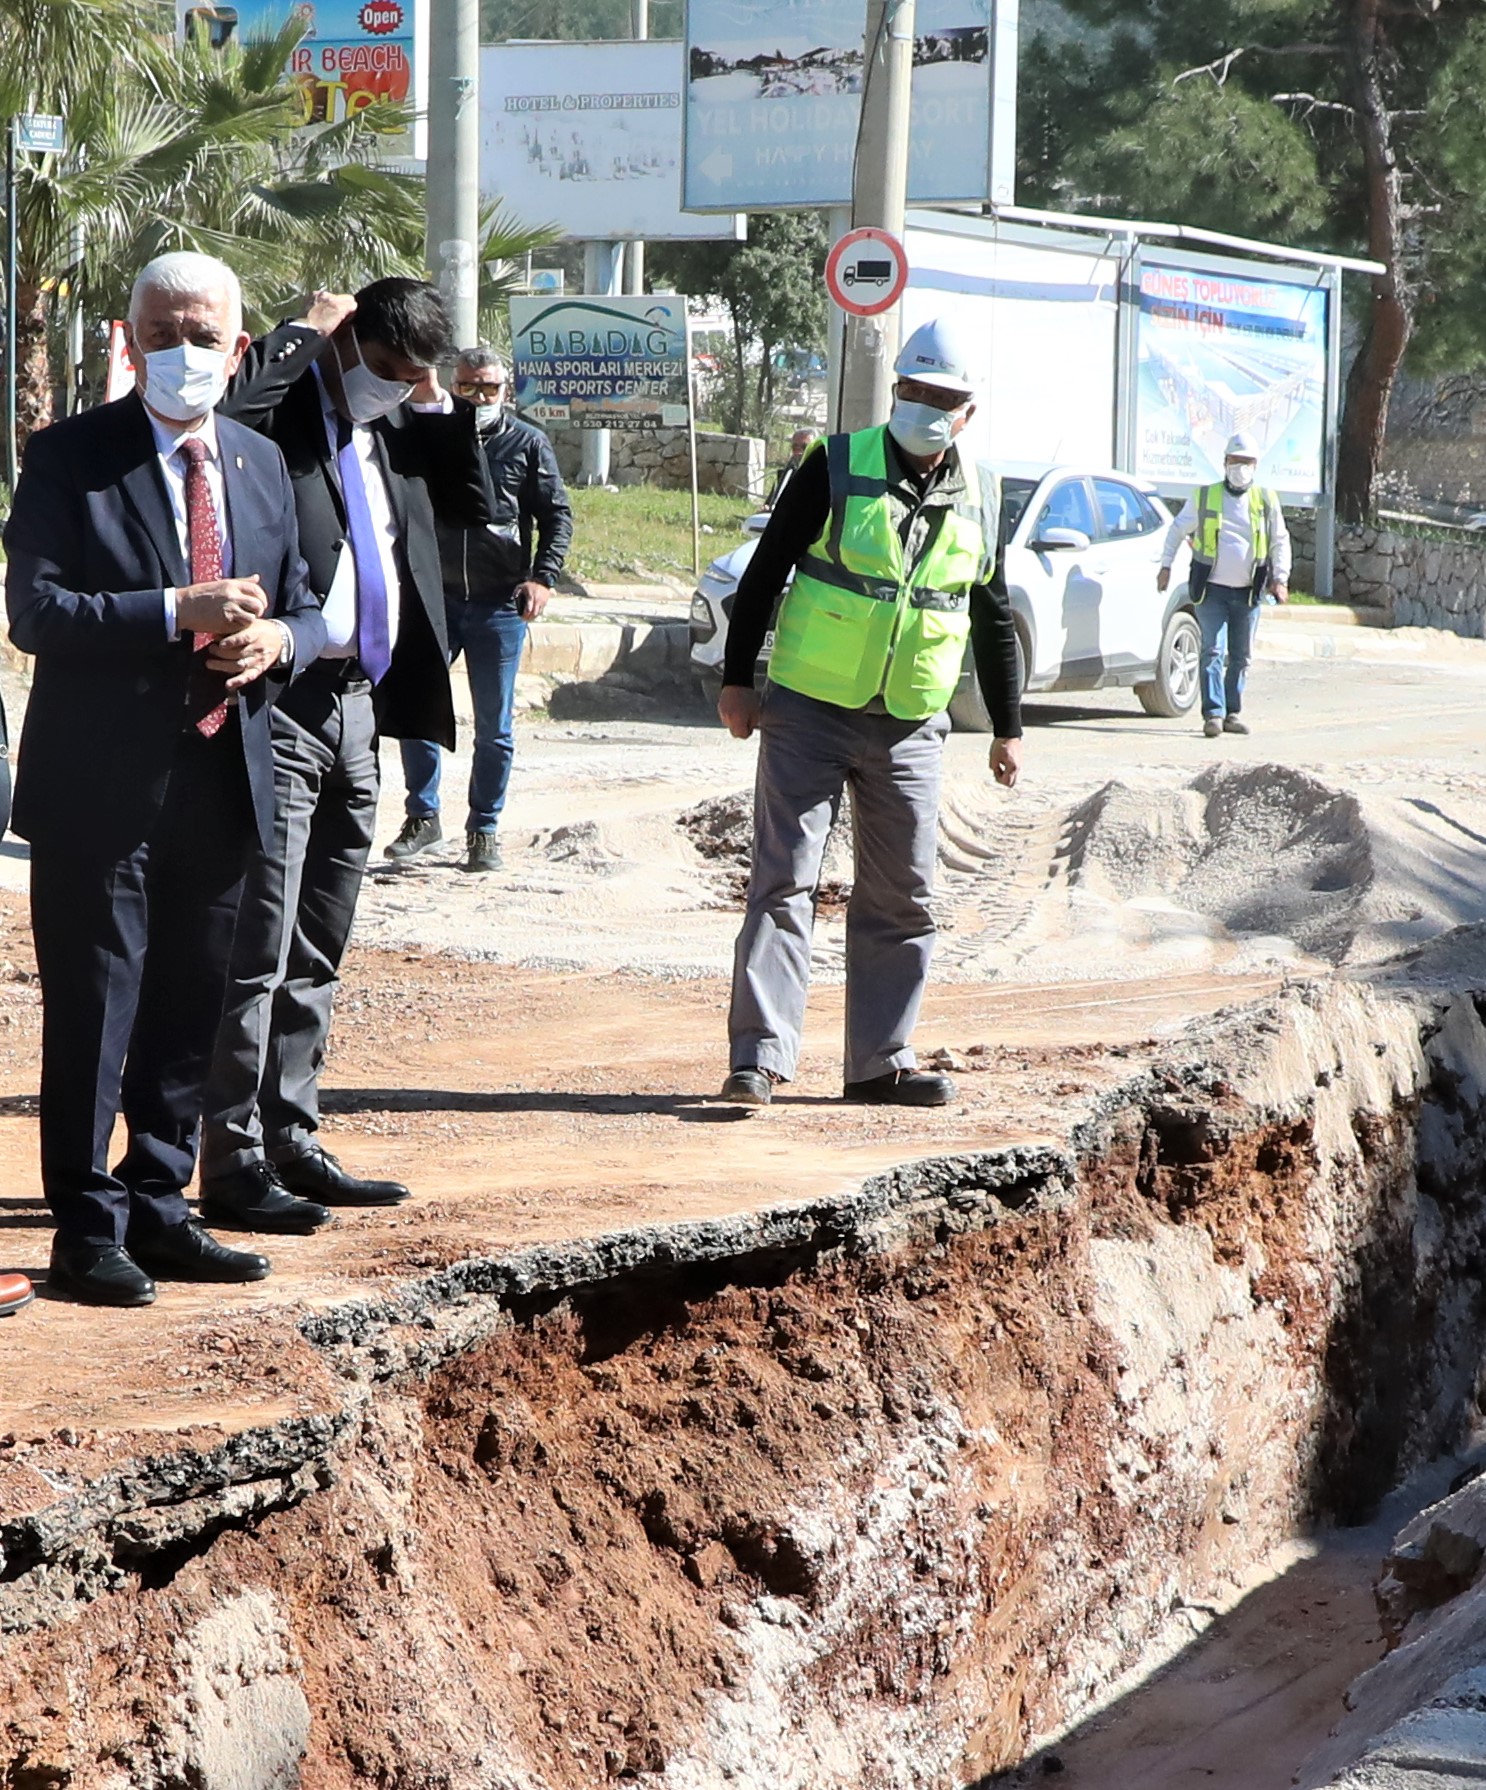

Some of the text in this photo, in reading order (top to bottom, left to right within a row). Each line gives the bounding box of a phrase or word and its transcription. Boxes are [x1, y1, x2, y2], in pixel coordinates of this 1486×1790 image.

[363, 8, 398, 28] Open
[291, 45, 403, 73] IR BEACH
[505, 93, 680, 112] HOTEL & PROPERTIES
[702, 106, 742, 136] YEL
[912, 100, 975, 124] SORT
[1142, 269, 1190, 303] GÜNEŞ
[1194, 304, 1224, 338] İÇİN
[518, 359, 683, 377] HAVA SPORLARI MERKEZİ
[535, 380, 669, 396] AIR SPORTS CENTER
[533, 406, 566, 418] 16 km
